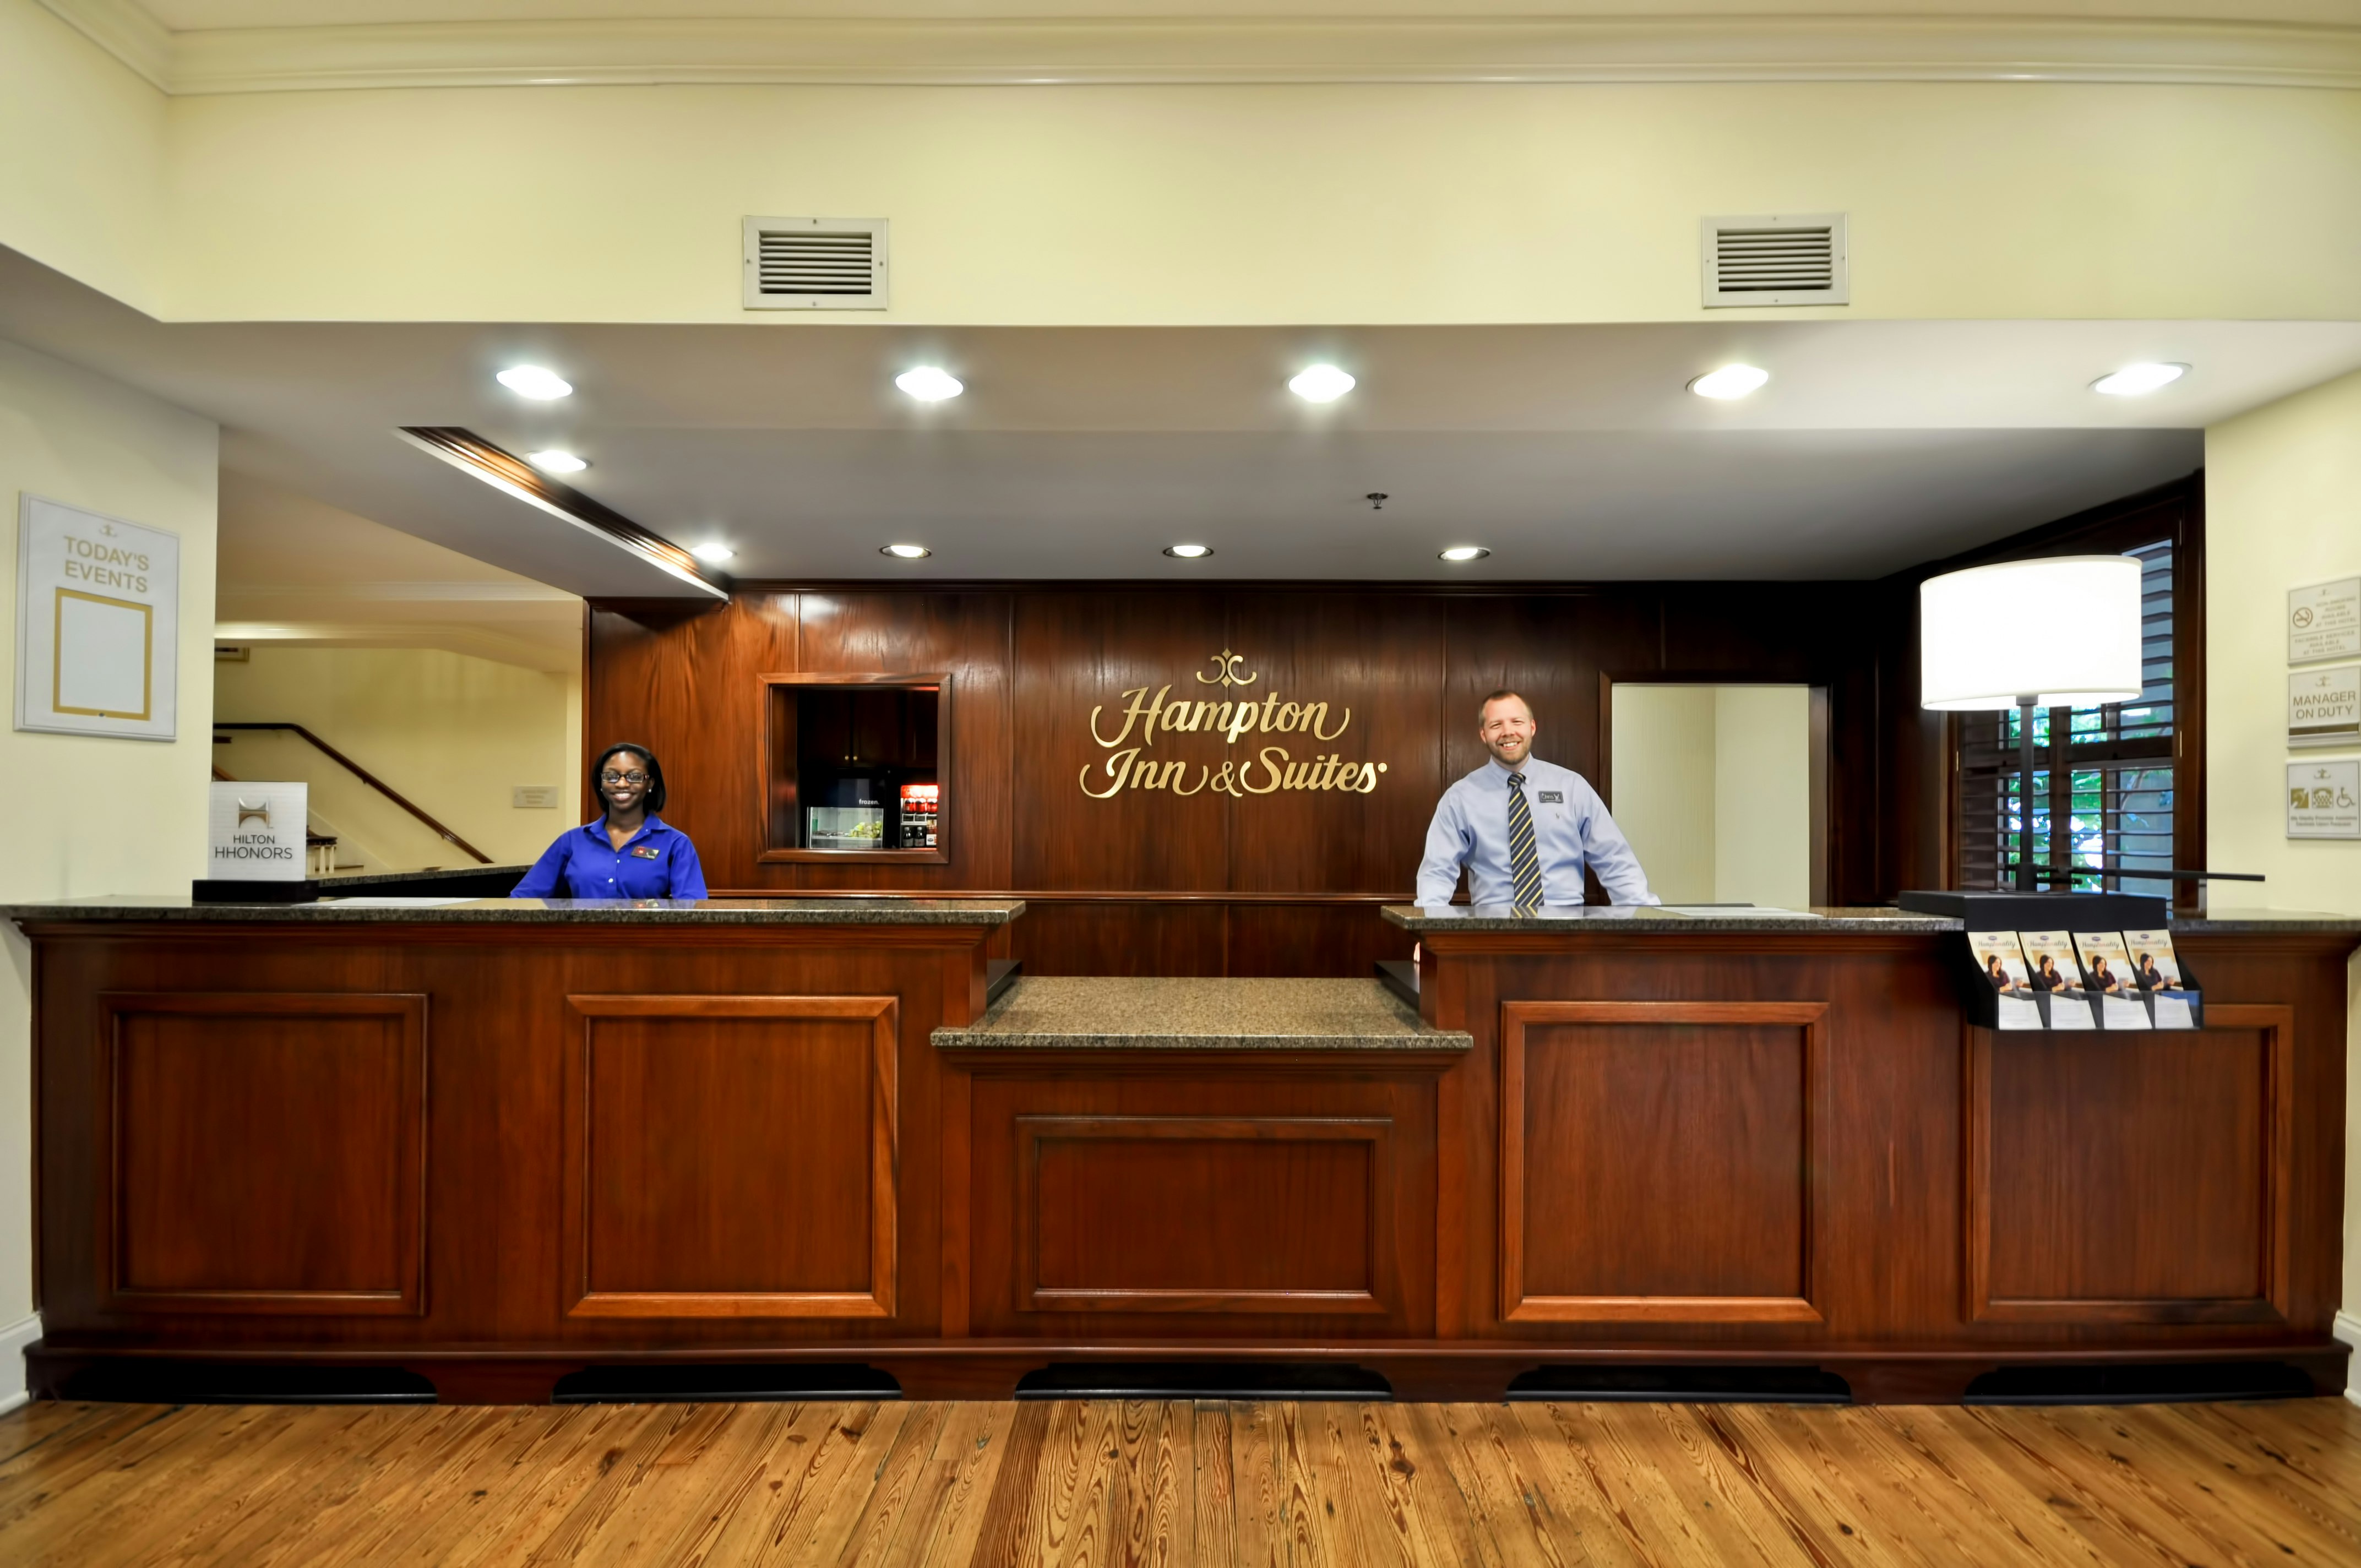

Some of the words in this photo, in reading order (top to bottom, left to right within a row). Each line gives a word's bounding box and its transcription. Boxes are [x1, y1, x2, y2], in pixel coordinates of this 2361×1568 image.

[63, 535, 149, 571] TODAY'S
[65, 559, 148, 593] EVENTS
[2293, 690, 2356, 706] MANAGER
[1091, 684, 1350, 748] Hampton
[2295, 708, 2314, 720] ON
[2318, 705, 2353, 718] DUTY
[1079, 747, 1209, 798] Inn
[1211, 761, 1243, 797] &
[233, 834, 275, 845] HILTON
[215, 846, 293, 859] HHONORS
